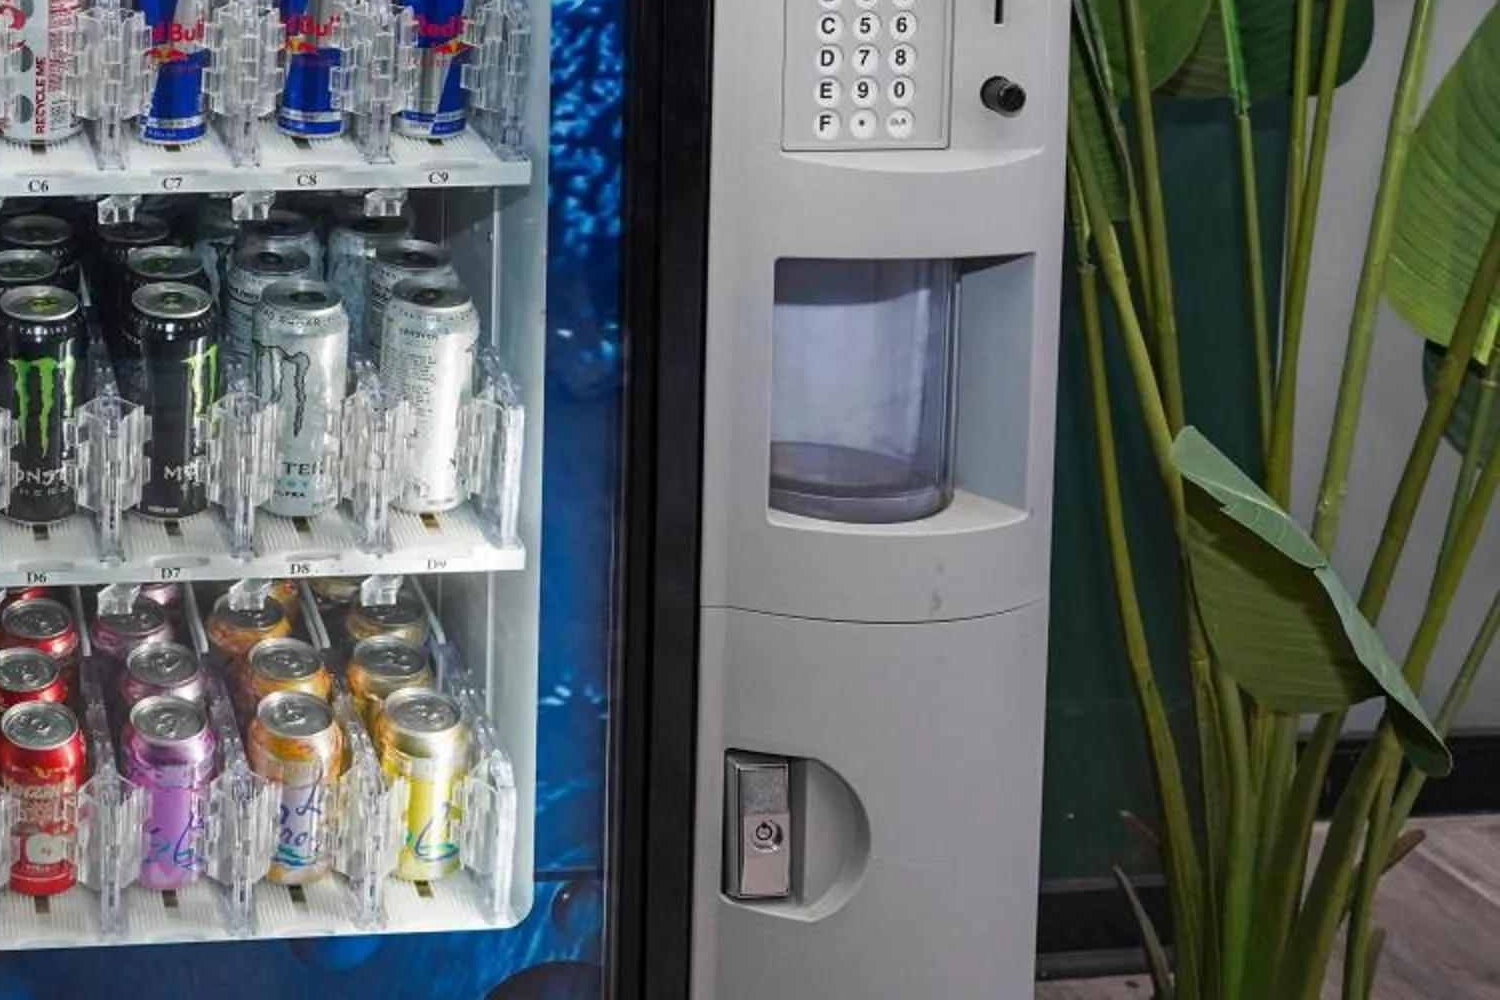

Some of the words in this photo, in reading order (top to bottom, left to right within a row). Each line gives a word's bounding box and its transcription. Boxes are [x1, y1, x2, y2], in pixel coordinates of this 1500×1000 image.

[822, 17, 835, 34] C
[860, 18, 870, 33] 5
[897, 17, 907, 32] 6
[821, 50, 834, 66] D
[860, 50, 870, 65] 7
[896, 50, 906, 65] 8
[35, 56, 47, 77] ME
[820, 82, 832, 98] E
[858, 82, 868, 98] 9
[894, 82, 905, 97] 0
[35, 79, 46, 135] RECYCLE
[820, 115, 831, 130] F
[161, 177, 183, 190] C7
[296, 174, 317, 187] C8
[428, 172, 449, 184] C9
[27, 180, 49, 193] C6
[161, 566, 181, 579] D7
[289, 562, 311, 575] D8
[27, 571, 47, 584] D6
